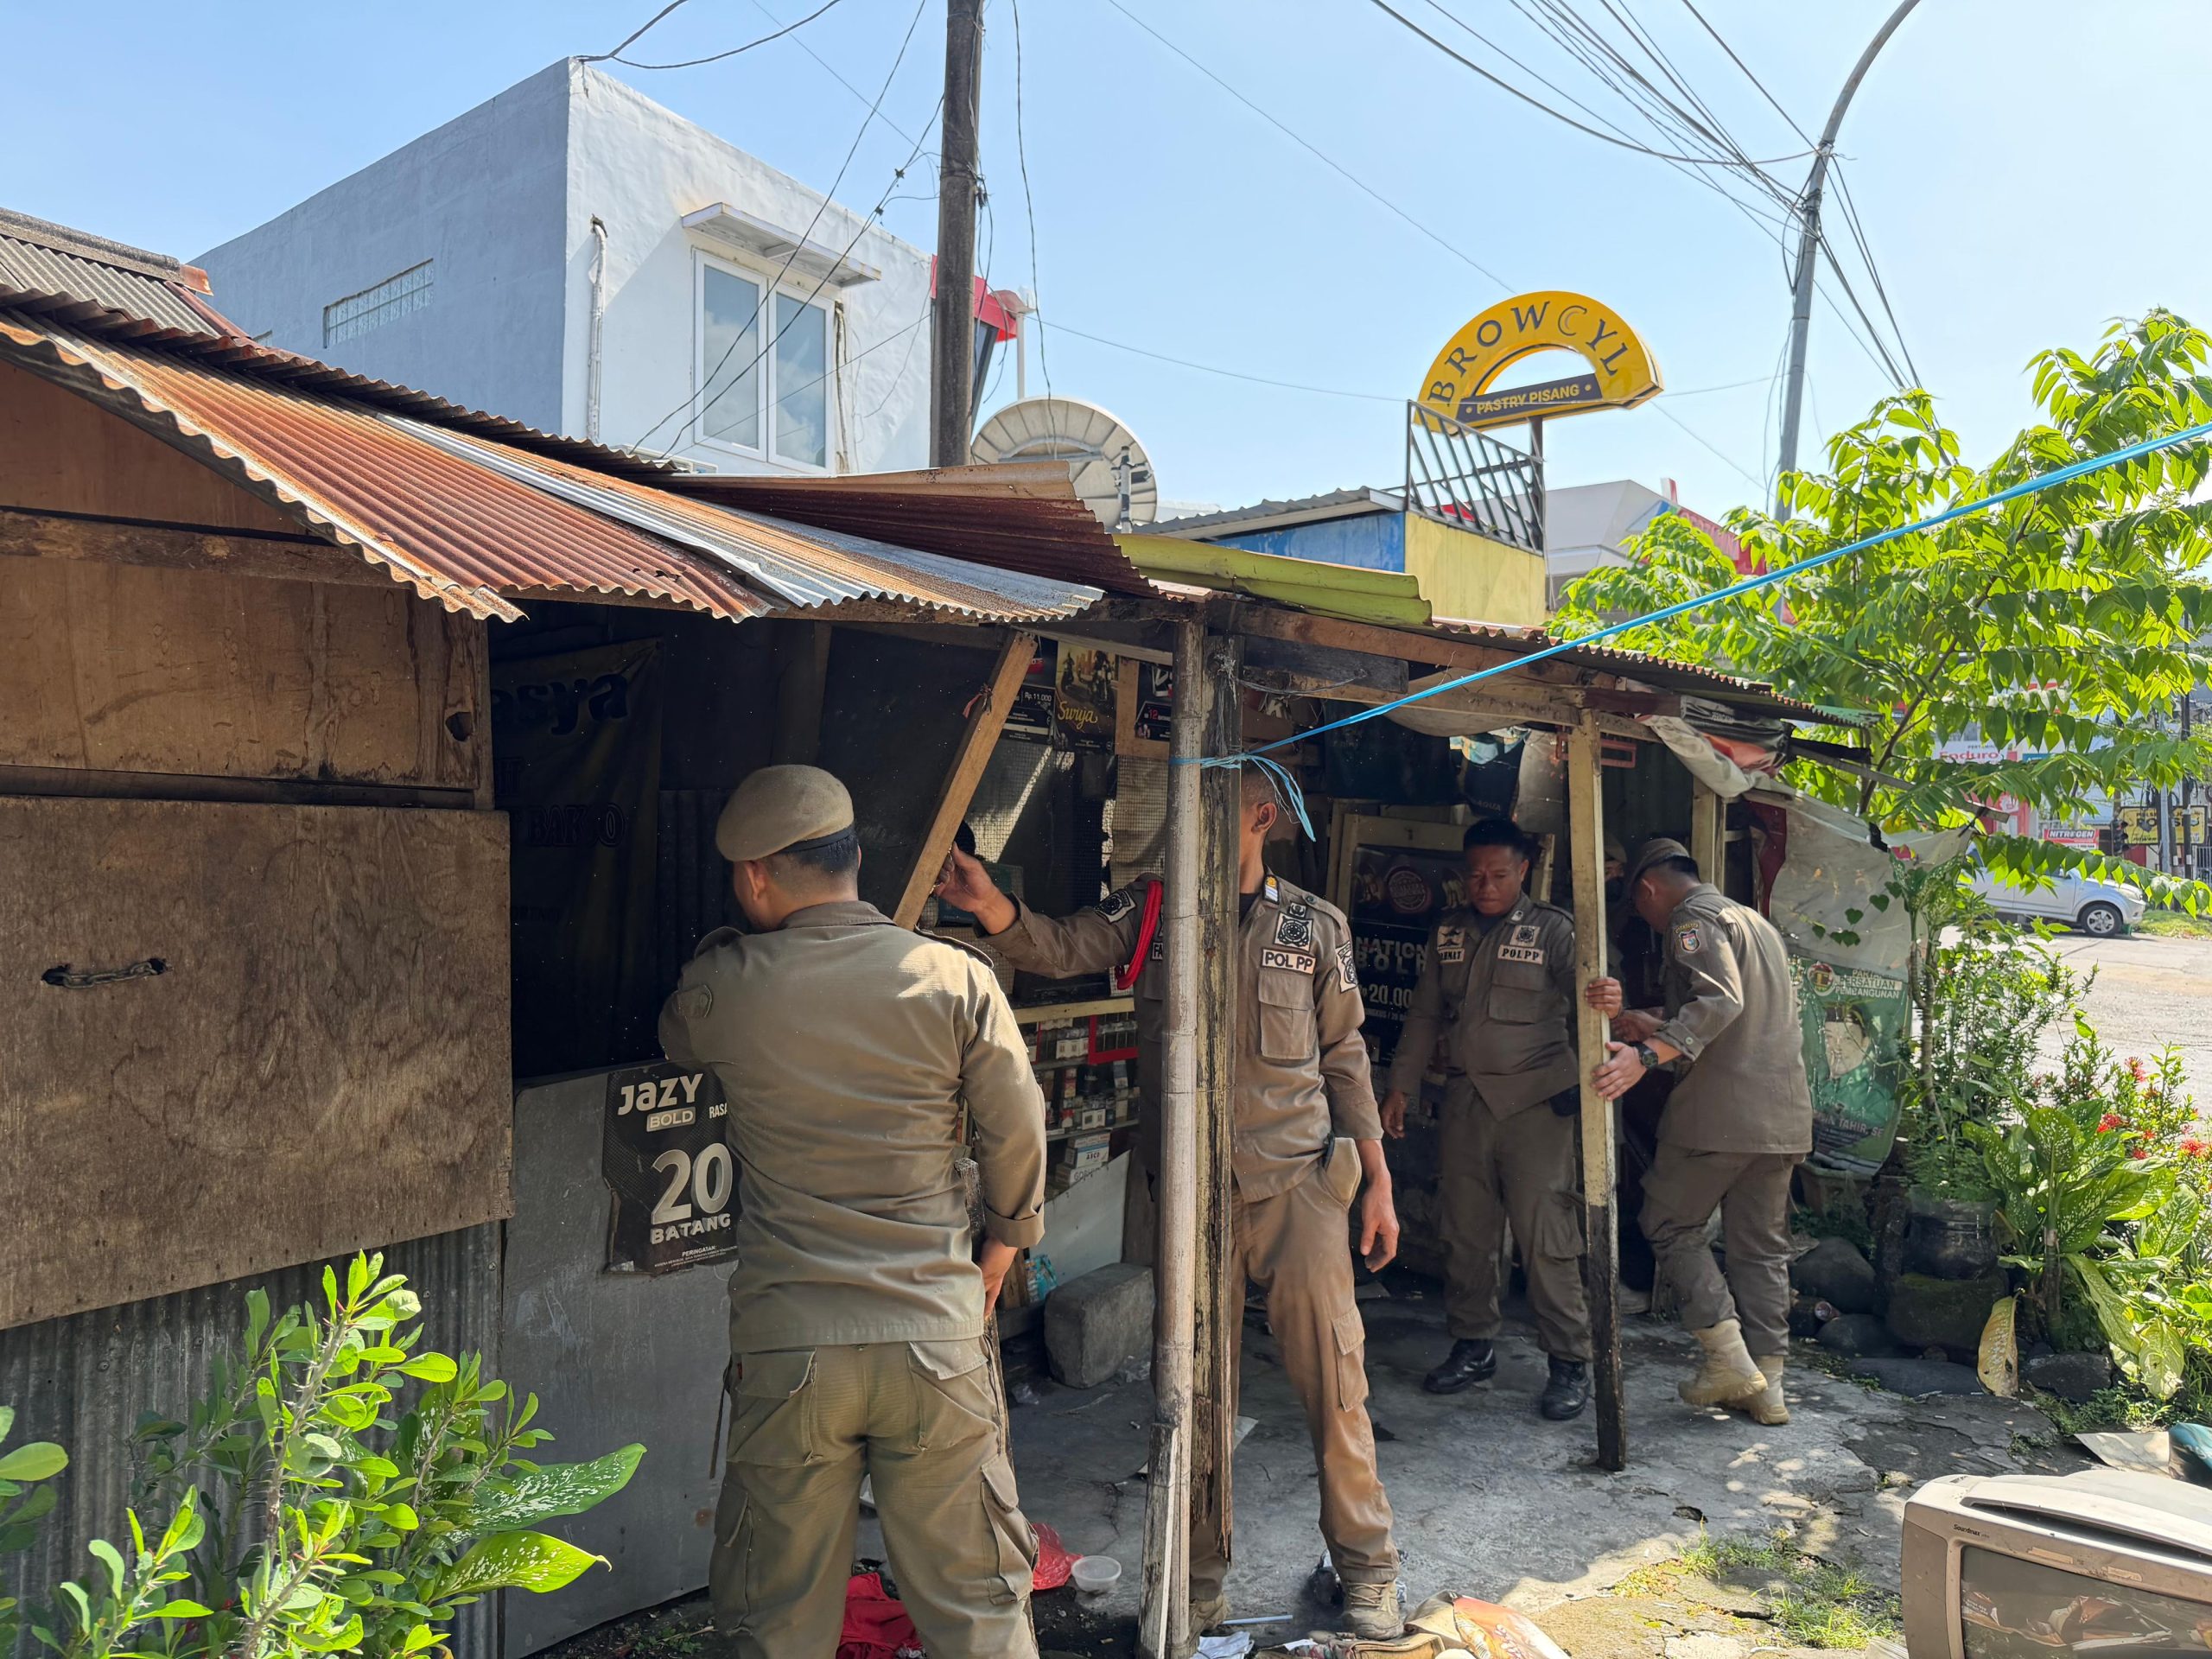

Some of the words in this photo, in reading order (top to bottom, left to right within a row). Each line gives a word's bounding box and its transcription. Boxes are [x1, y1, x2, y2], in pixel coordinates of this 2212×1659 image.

[1427, 300, 1629, 407] BROWCYL
[1477, 396, 1527, 415] PASTRY
[1529, 384, 1580, 404] PISANG
[1057, 700, 1098, 730] Surya
[1939, 750, 1999, 760] Enduro
[1265, 951, 1294, 968] POL
[1296, 956, 1313, 971] PP
[1503, 948, 1522, 958] POL
[1524, 950, 1539, 961] PP
[1835, 986, 1900, 1000] PEMBANGUNAN
[1840, 977, 1896, 990] PERSATUAN
[649, 1109, 694, 1129] BOLD
[652, 1142, 734, 1225] 20
[650, 1213, 732, 1244] BATANG
[682, 1245, 717, 1257] PERINGATAN:
